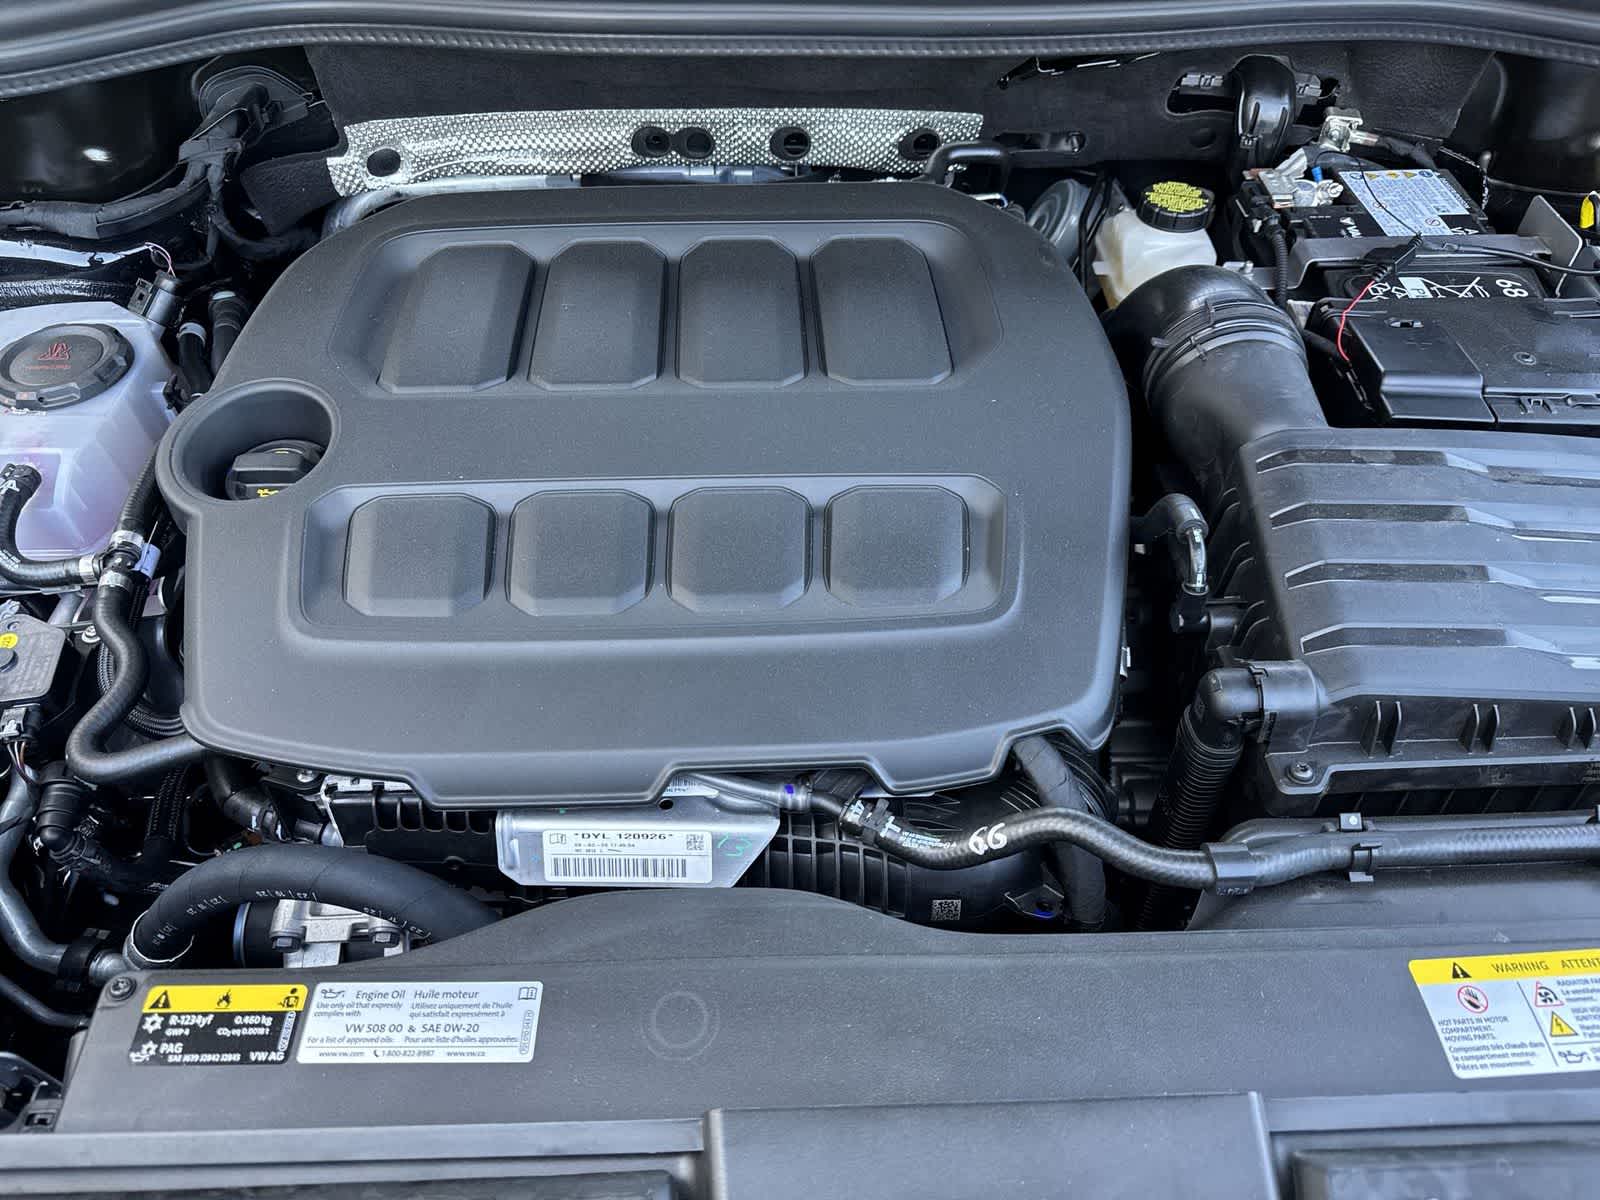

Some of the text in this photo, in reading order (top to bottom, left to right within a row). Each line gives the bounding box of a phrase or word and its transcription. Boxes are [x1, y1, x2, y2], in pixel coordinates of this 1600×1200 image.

[1495, 278, 1529, 298] 68
[1491, 960, 1549, 974] WARNING
[355, 990, 406, 1001] Engine Oil
[414, 990, 480, 999] Huile moteur
[330, 1002, 345, 1010] only
[345, 1001, 355, 1009] oil
[356, 1001, 370, 1009] that
[371, 1002, 403, 1011] expressly
[411, 1002, 438, 1010] Utilisez
[438, 1002, 481, 1011] uniquement
[482, 1002, 490, 1010] de
[313, 1011, 344, 1019] complies
[409, 1011, 420, 1020] qui
[421, 1010, 450, 1018] satisfait
[450, 1010, 499, 1019] expressément
[168, 1014, 273, 1028] R-1234yf 0.460 kg
[1438, 1019, 1451, 1027] HOT
[1453, 1018, 1474, 1026] PARTS
[1484, 1015, 1509, 1023] MOTOR
[345, 1023, 480, 1033] VW 508 00 & SAE 0W-20
[345, 1036, 380, 1045] approved
[1444, 1034, 1473, 1042] MOVING
[159, 1043, 183, 1054] PAG
[1448, 1044, 1490, 1053] Composants
[249, 1052, 269, 1061] VW
[269, 1051, 285, 1061] AG
[1460, 1052, 1510, 1061] compartiment
